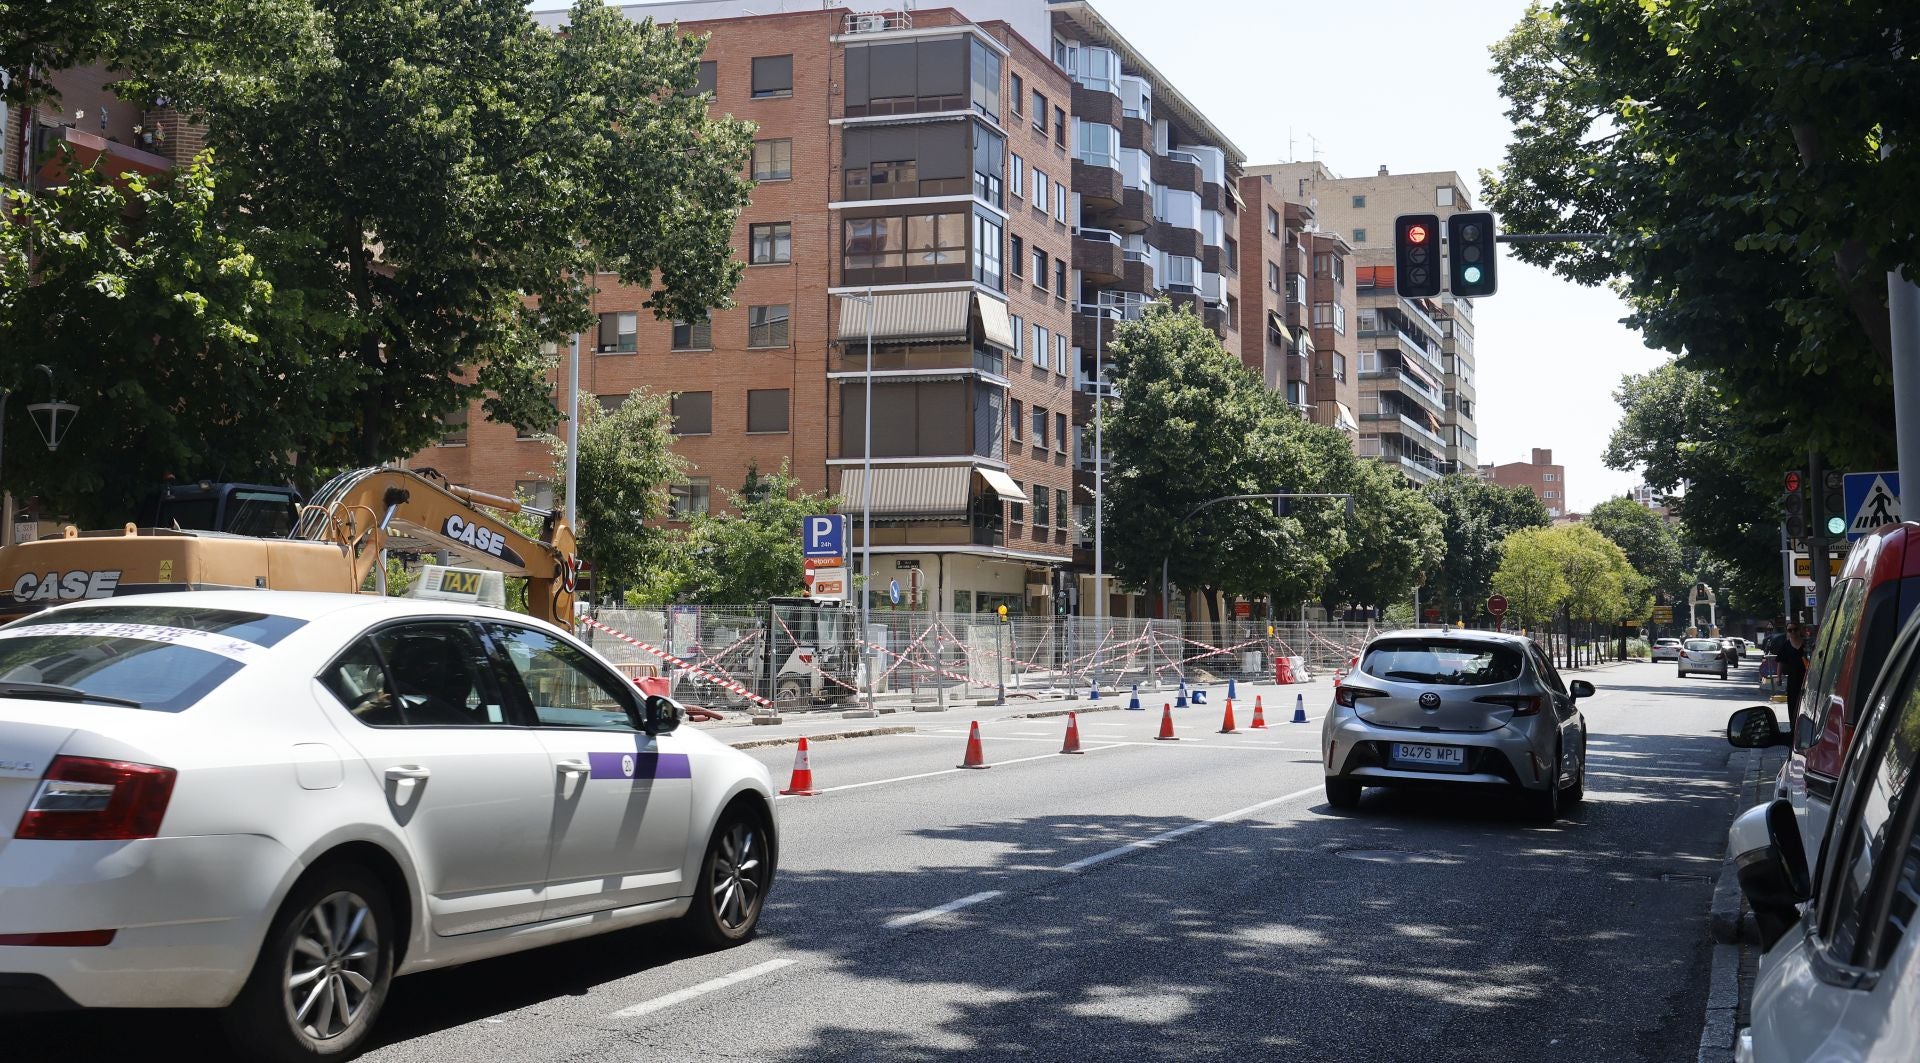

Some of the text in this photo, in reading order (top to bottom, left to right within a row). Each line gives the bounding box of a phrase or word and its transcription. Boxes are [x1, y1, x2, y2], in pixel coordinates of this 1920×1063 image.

[447, 514, 506, 557] CASE
[812, 517, 833, 548] P
[13, 570, 122, 602] CASE
[444, 572, 481, 593] TAXI
[118, 623, 209, 637] PALENCIA
[1401, 746, 1461, 760] 9476 MPL
[624, 760, 632, 772] 20
